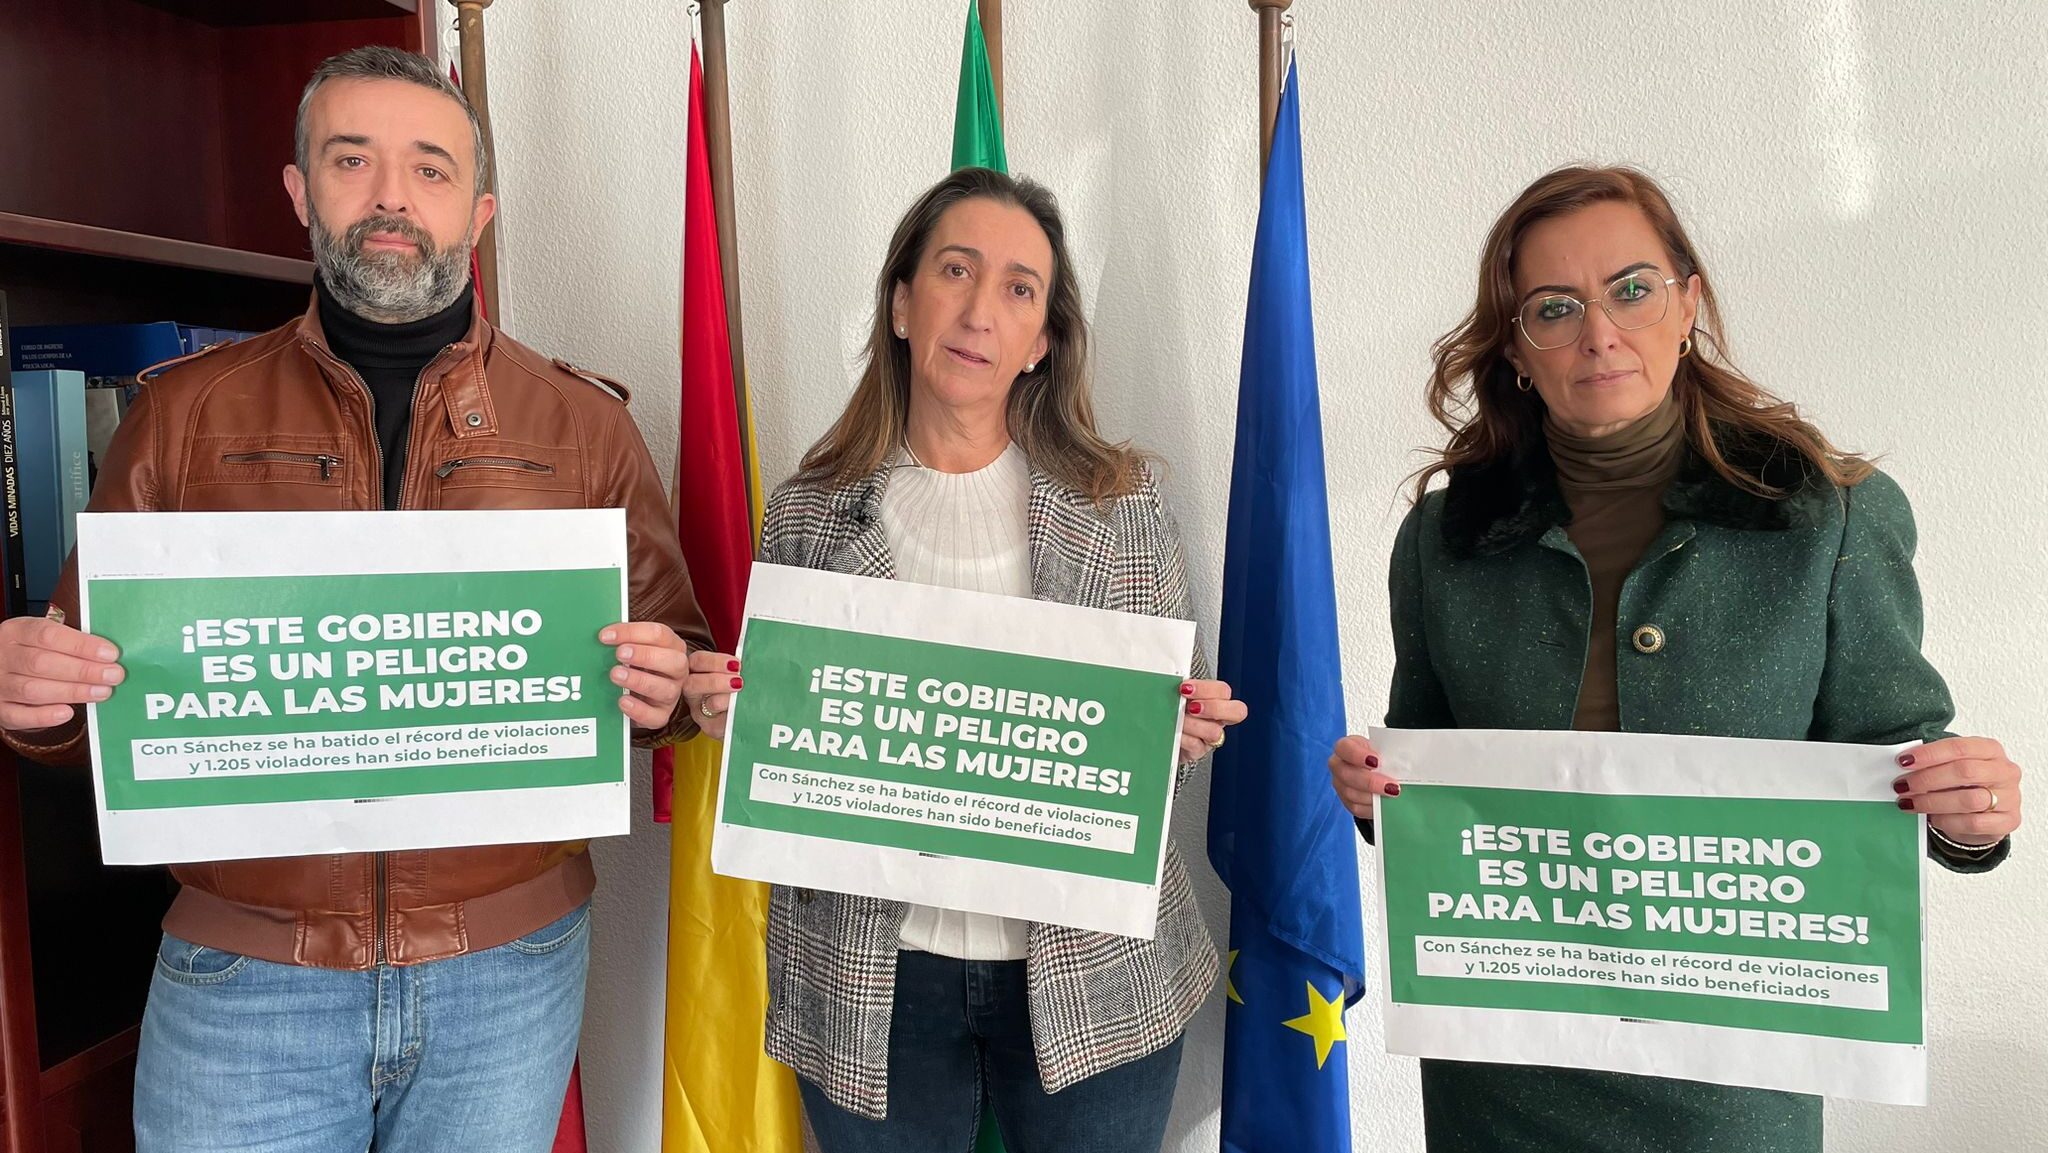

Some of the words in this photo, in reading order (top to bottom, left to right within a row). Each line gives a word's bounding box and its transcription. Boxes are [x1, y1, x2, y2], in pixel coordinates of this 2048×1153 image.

[1, 419, 12, 443] AÑOS
[3, 444, 14, 463] DIEZ
[5, 467, 17, 509] MINADAS
[8, 510, 19, 537] VIDAS
[181, 616, 305, 653] ¡ESTE
[317, 609, 542, 643] GOBIERNO
[202, 654, 257, 683] ES
[269, 651, 332, 681] UN
[346, 644, 528, 677] PELIGRO
[145, 690, 273, 720] PARA
[284, 686, 367, 715] LAS
[380, 676, 582, 711] MUJERES!
[809, 665, 908, 700] ¡ESTE
[917, 678, 1105, 726] GOBIERNO
[140, 743, 178, 757] Con
[183, 739, 264, 755] Sánchez
[267, 740, 289, 752] se
[293, 736, 316, 750] ha
[321, 733, 380, 749] batido
[384, 731, 401, 746] el
[405, 727, 463, 744] récord
[467, 727, 490, 741] de
[493, 723, 590, 739] violaciones
[820, 698, 864, 726] ES
[874, 705, 925, 735] UN
[934, 713, 1088, 756] PELIGRO
[188, 758, 201, 776] y
[204, 757, 251, 772] 1.205
[255, 754, 351, 770] violadores
[355, 751, 390, 765] han
[394, 748, 432, 763] sido
[436, 742, 549, 760] beneficiados
[770, 724, 868, 761] PARA
[878, 738, 947, 770] LAS
[956, 749, 1132, 796] MUJERES!
[758, 767, 788, 784] Con
[791, 772, 856, 793] Sánchez
[858, 783, 876, 795] se
[879, 783, 898, 798] ha
[901, 786, 951, 805] batido
[953, 794, 969, 808] el
[971, 797, 1021, 815] récord
[1023, 803, 1044, 818] de
[1046, 806, 1132, 831] violaciones
[792, 791, 803, 805] y
[805, 791, 843, 808] 1.205
[845, 797, 924, 819] violadores
[926, 807, 956, 824] han
[958, 812, 991, 828] sido
[994, 816, 1093, 842] beneficiados
[1461, 824, 1571, 856] ¡ESTE
[1583, 832, 1822, 868] GOBIERNO
[1479, 859, 1528, 887] ES
[1539, 862, 1598, 893] UN
[1612, 869, 1805, 904] PELIGRO
[1428, 892, 1542, 922] PARA
[1553, 898, 1633, 930] LAS
[1645, 905, 1869, 945] MUJERES!
[1422, 939, 1456, 954] Con
[1459, 941, 1533, 958] Sánchez
[1536, 947, 1557, 959] se
[1560, 946, 1583, 961] ha
[1587, 948, 1646, 967] batido
[1650, 954, 1667, 968] el
[1672, 955, 1733, 972] récord
[1738, 959, 1763, 975] de
[1767, 961, 1880, 985] violaciones
[1464, 962, 1476, 976] y
[1478, 960, 1522, 976] 1.205
[1524, 962, 1618, 983] violadores
[1620, 969, 1657, 986] han
[1660, 972, 1700, 988] sido
[1704, 975, 1831, 1000] beneficiados
